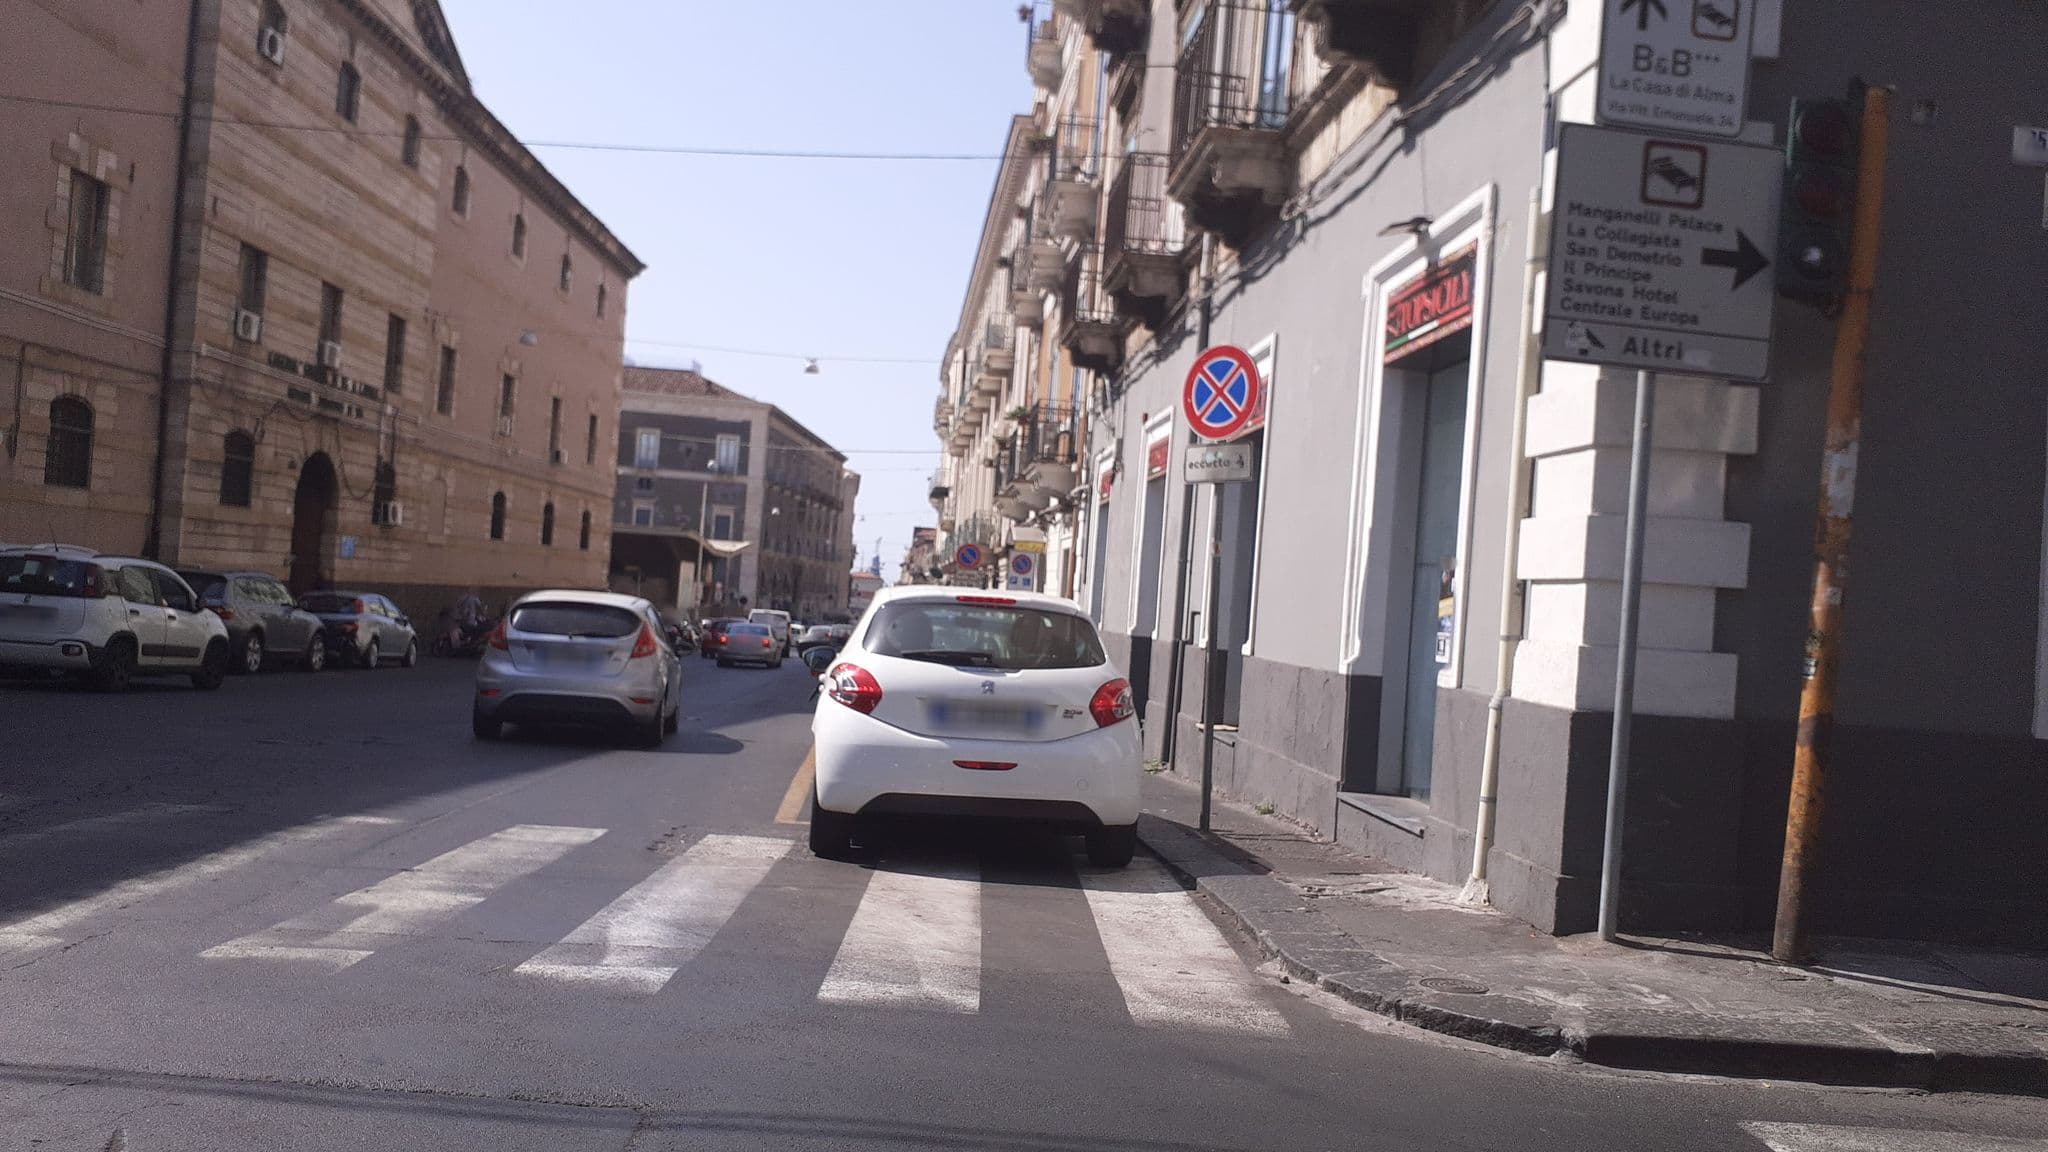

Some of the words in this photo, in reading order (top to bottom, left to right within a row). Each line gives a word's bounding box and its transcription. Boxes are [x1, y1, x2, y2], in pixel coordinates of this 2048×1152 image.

[1567, 202, 1661, 224] Manganelli
[1668, 213, 1723, 232] Palace
[1567, 223, 1587, 238] La
[1594, 225, 1681, 248] Collegiata
[1566, 241, 1599, 258] San
[1606, 246, 1682, 267] Demetrio
[1584, 262, 1653, 283] Principe
[1562, 277, 1625, 298] Savona
[1632, 285, 1679, 304] Hotel
[1560, 297, 1633, 319] Centrale
[1640, 303, 1700, 326] Europa
[1623, 336, 1684, 361] Altri
